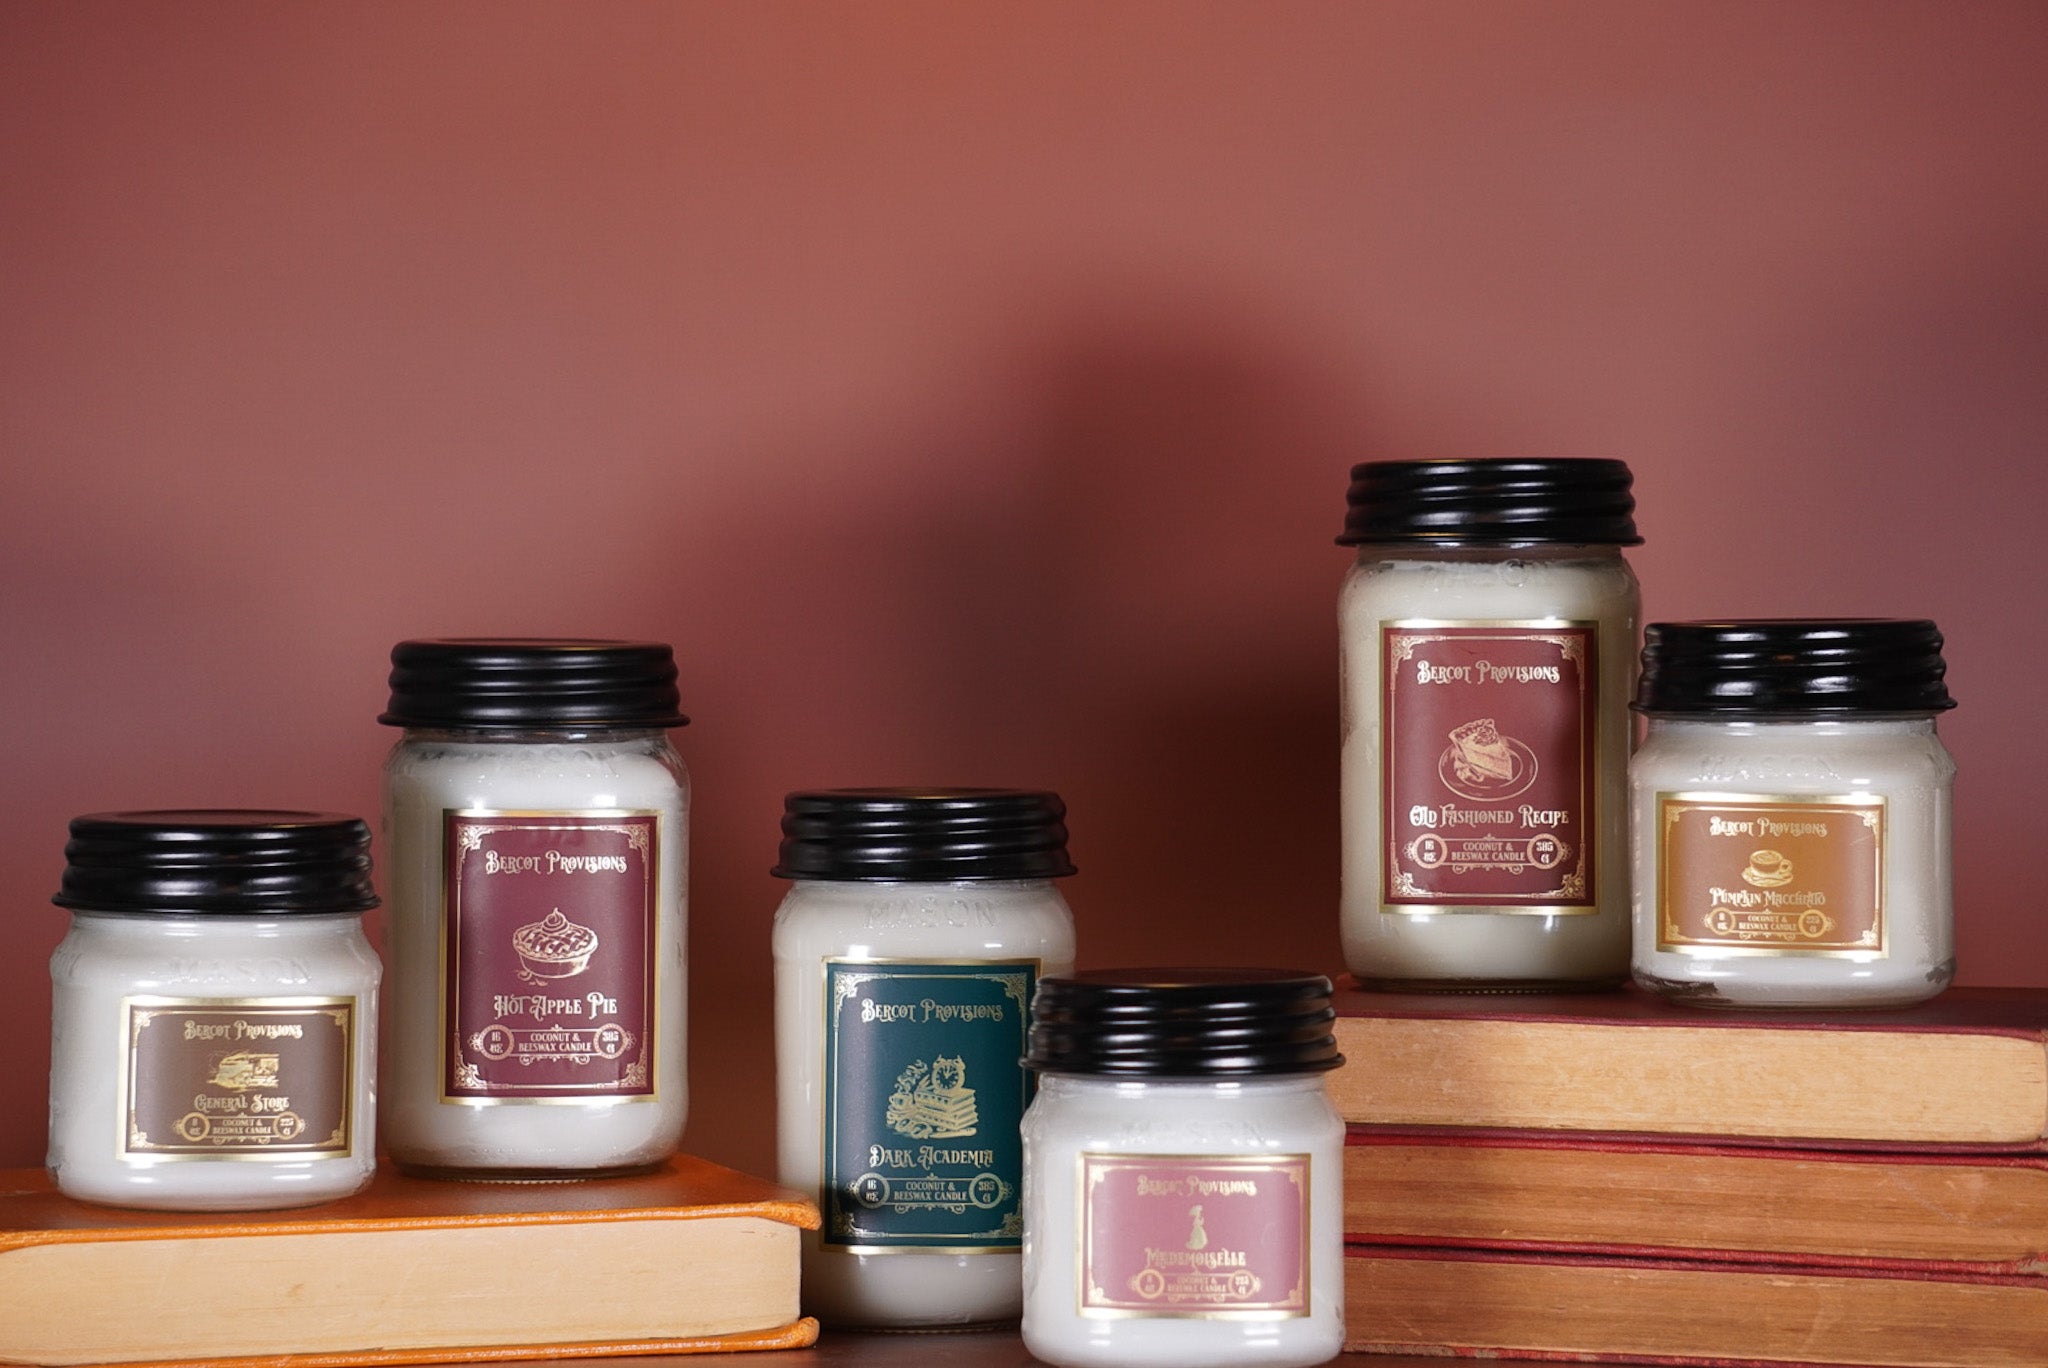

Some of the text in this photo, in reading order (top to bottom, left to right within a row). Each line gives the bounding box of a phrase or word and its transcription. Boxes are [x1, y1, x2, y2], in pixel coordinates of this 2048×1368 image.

[1417, 660, 1560, 685] BERCOT PROVISIONS
[1440, 804, 1514, 827] FASHIONED
[1518, 805, 1570, 828] RECIPE
[1710, 816, 1827, 837] BERCOT PROVISIONS
[1425, 840, 1435, 850] 16
[1463, 842, 1513, 851] COCONUT &
[485, 850, 627, 874] BERCOT PROVISIONS
[1451, 852, 1526, 861] BEESWAX CANDLE
[1709, 887, 1761, 907] PUMPKIN
[1771, 923, 1797, 931] CANDLE
[494, 992, 617, 1021] HOT APPLE PIE
[861, 998, 1004, 1023] BERCOT PROVISIONS
[184, 1020, 303, 1040] BERCOT PROVISIONS
[531, 1033, 580, 1042] COCONUT &
[519, 1042, 591, 1051] BEESWAX CANDLE
[194, 1094, 290, 1113] GENERAL STORE
[869, 1144, 993, 1171] DARK ACADEMIA
[867, 1180, 876, 1190] 16
[906, 1182, 955, 1191] COCONUT &
[1186, 1175, 1257, 1196] PROVISIONS
[894, 1191, 967, 1201] BEESWAX CANDLE
